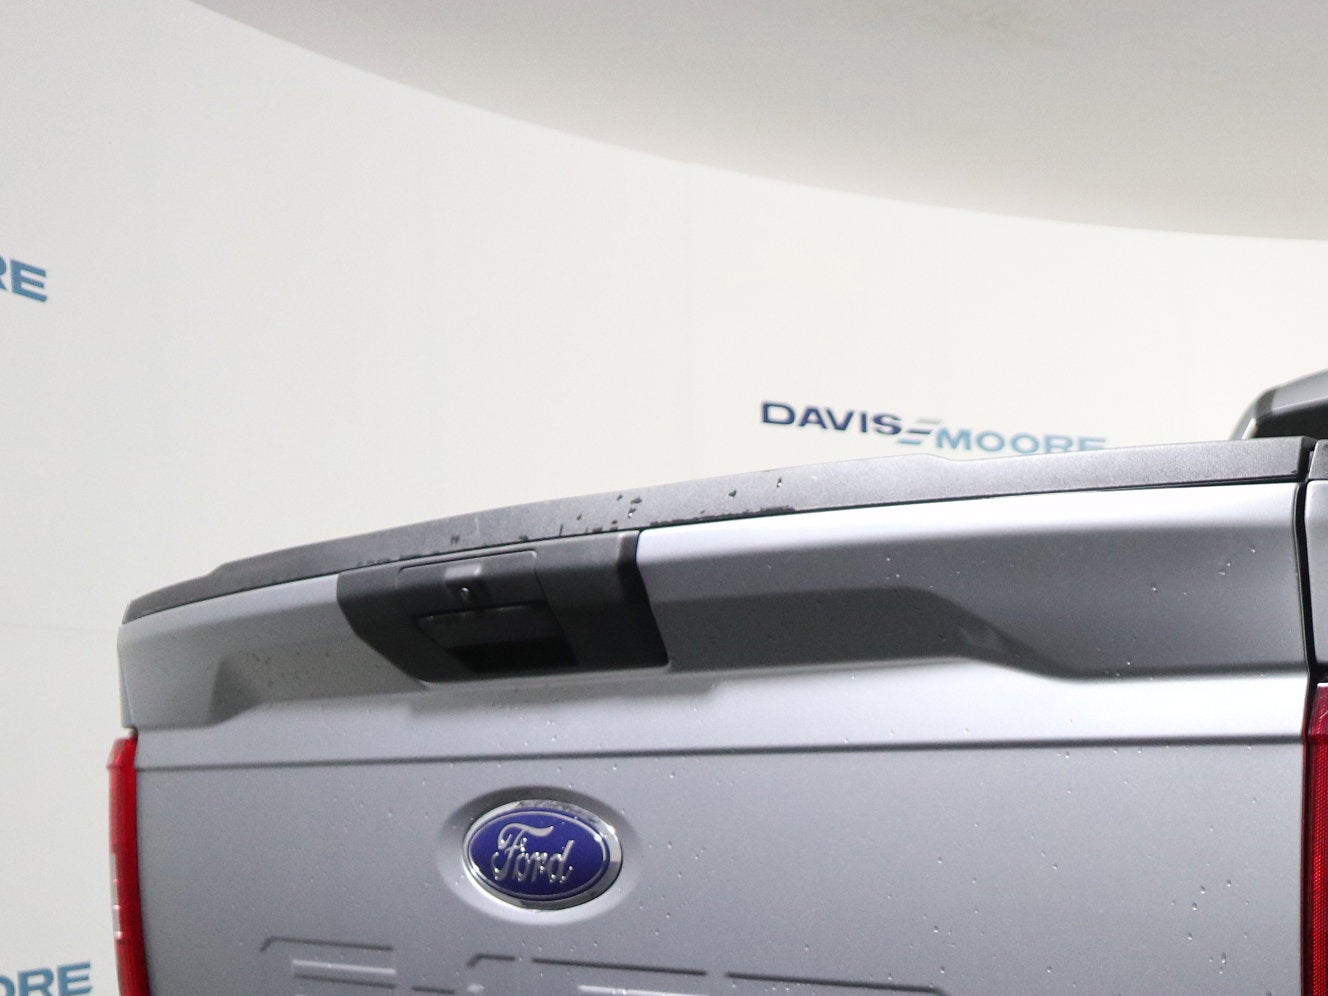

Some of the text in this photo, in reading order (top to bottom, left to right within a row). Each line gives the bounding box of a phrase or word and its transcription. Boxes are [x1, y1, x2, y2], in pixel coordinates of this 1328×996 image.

[761, 400, 1108, 453] DAVIS MOORE
[491, 822, 576, 884] Ford
